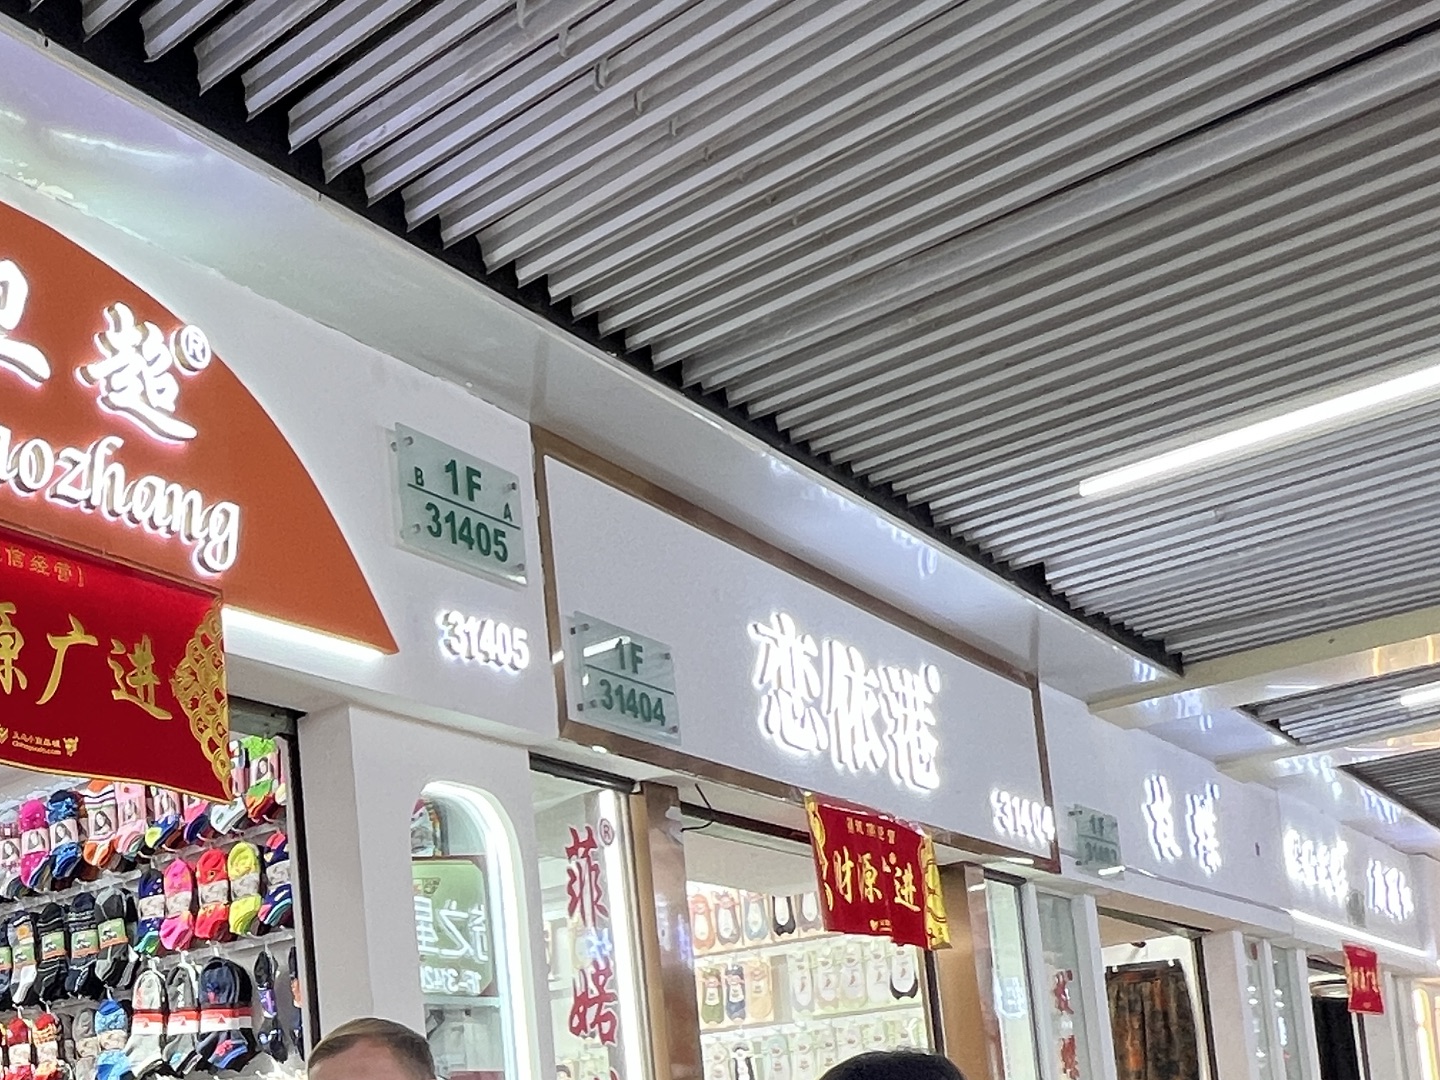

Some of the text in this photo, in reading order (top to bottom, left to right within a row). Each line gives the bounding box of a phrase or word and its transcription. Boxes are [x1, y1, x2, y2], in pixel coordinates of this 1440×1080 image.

[413, 458, 513, 522] B 1F A
[424, 502, 509, 562] 31405
[438, 610, 529, 671] 31405
[599, 678, 666, 727] 31404
